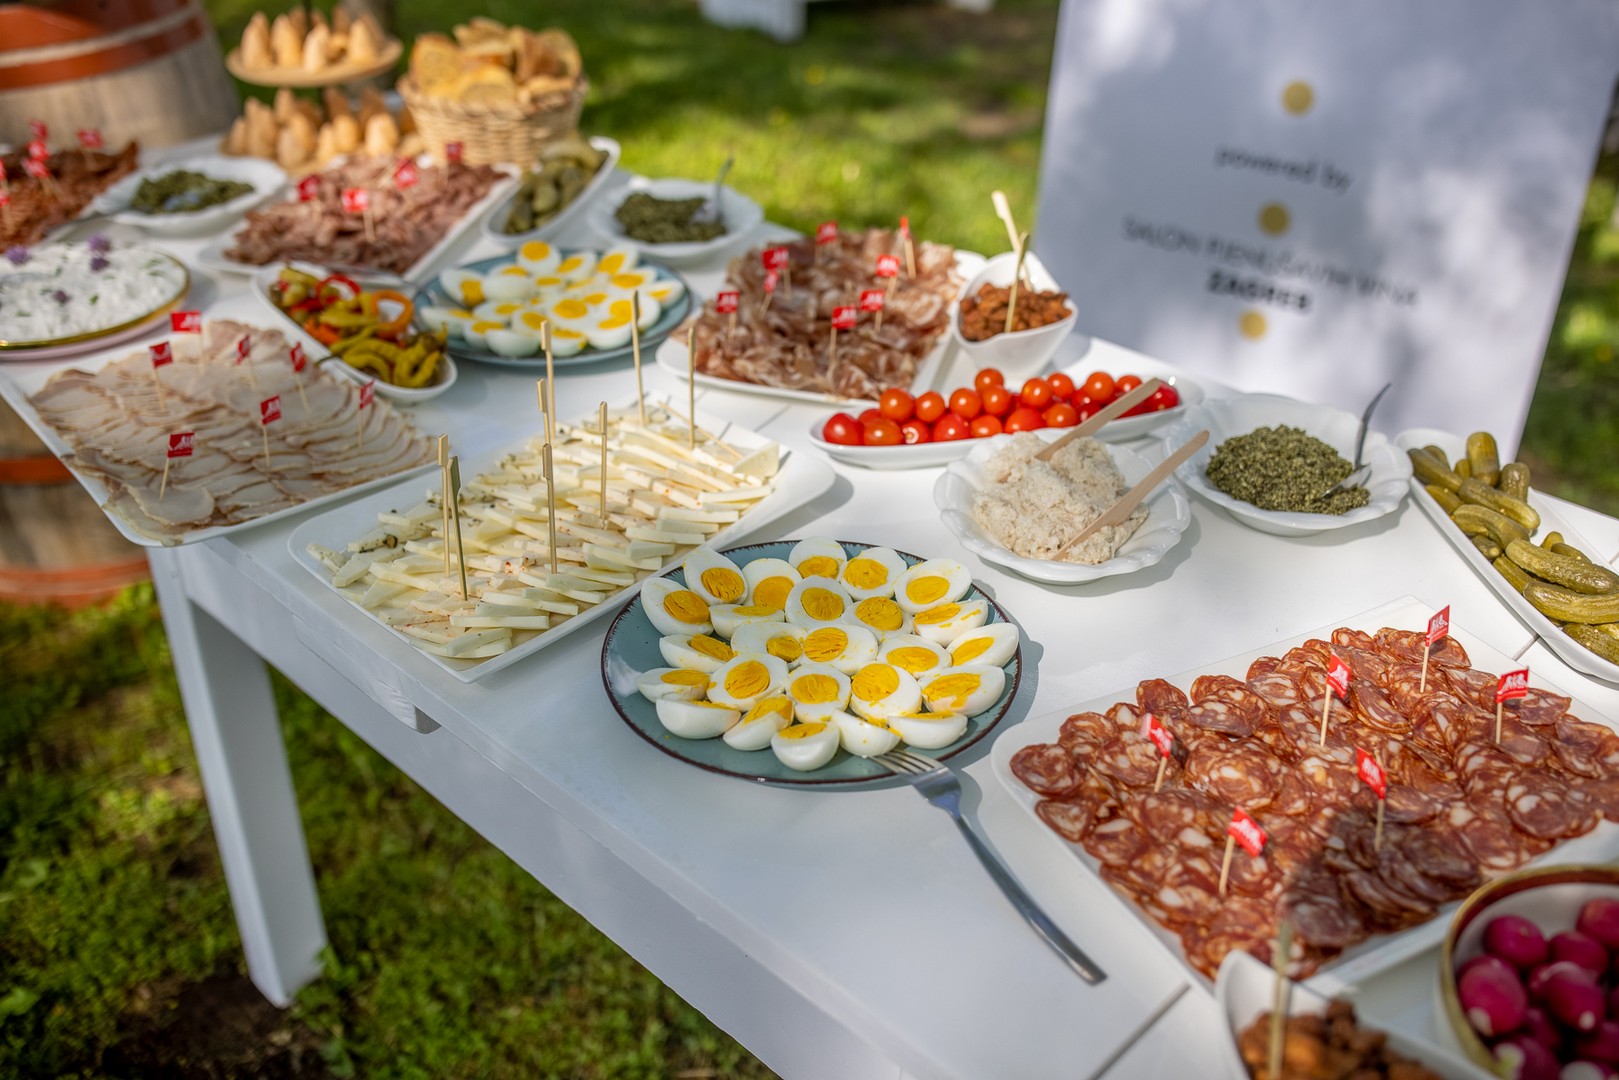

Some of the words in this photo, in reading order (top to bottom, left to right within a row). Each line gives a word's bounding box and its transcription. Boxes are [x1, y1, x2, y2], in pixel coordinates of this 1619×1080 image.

[1214, 147, 1320, 186] powered
[1321, 161, 1353, 196] by
[1122, 214, 1202, 256] SALON
